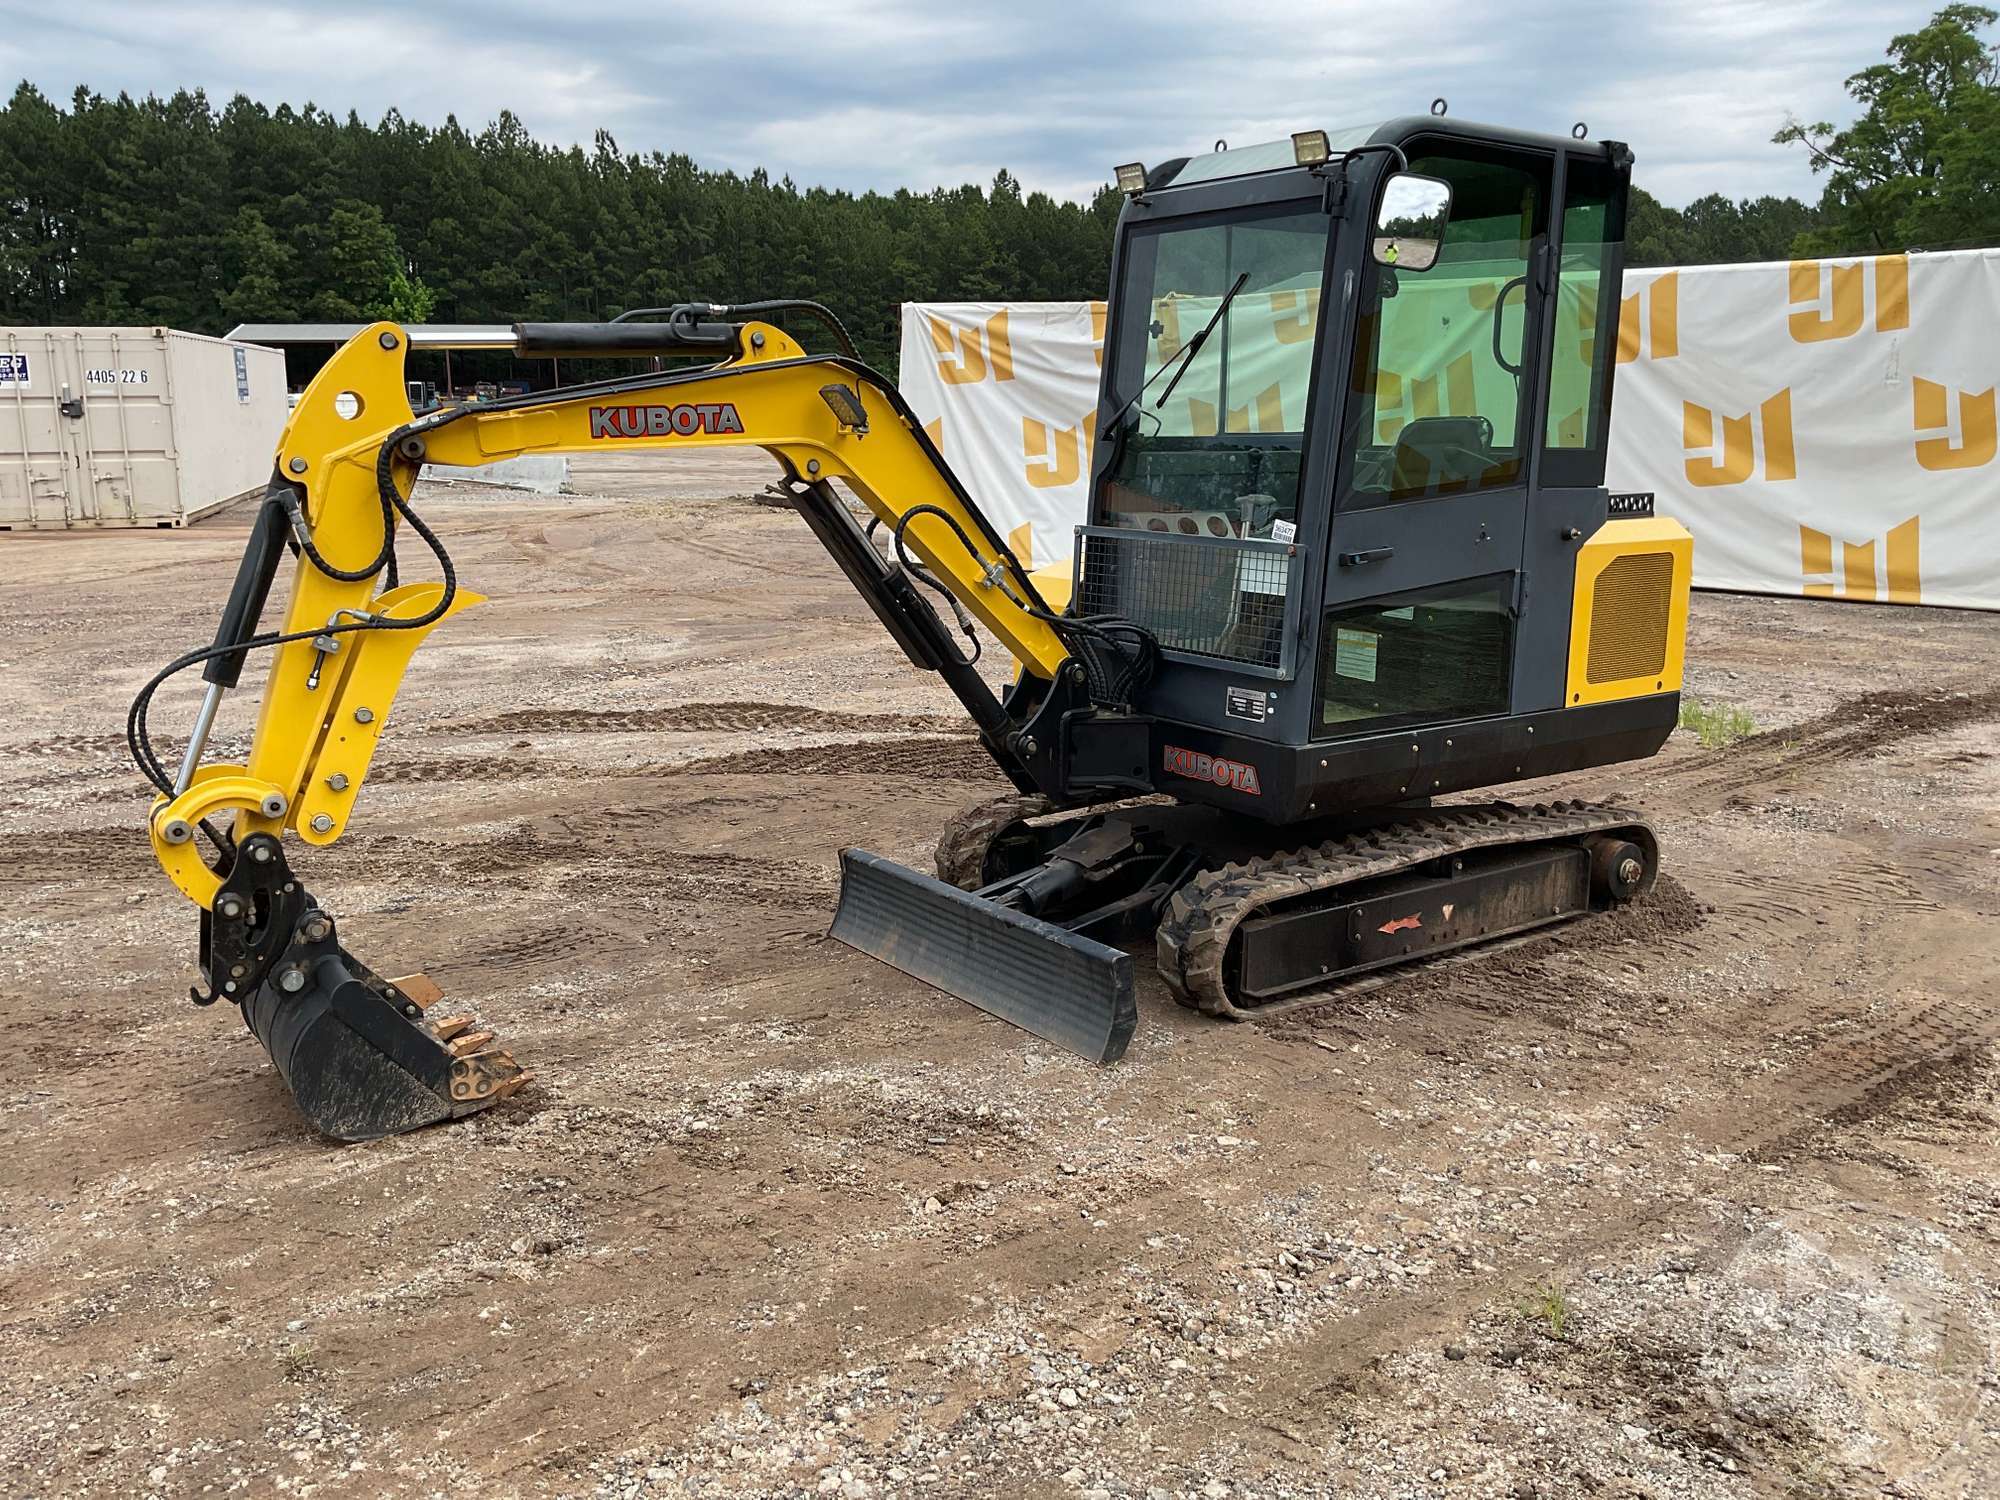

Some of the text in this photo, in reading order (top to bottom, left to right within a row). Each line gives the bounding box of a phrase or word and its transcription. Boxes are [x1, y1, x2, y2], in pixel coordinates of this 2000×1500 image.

[87, 370, 148, 383] 4405 22 6
[590, 404, 744, 438] KUBOTA
[1164, 745, 1261, 794] KUBOTA
